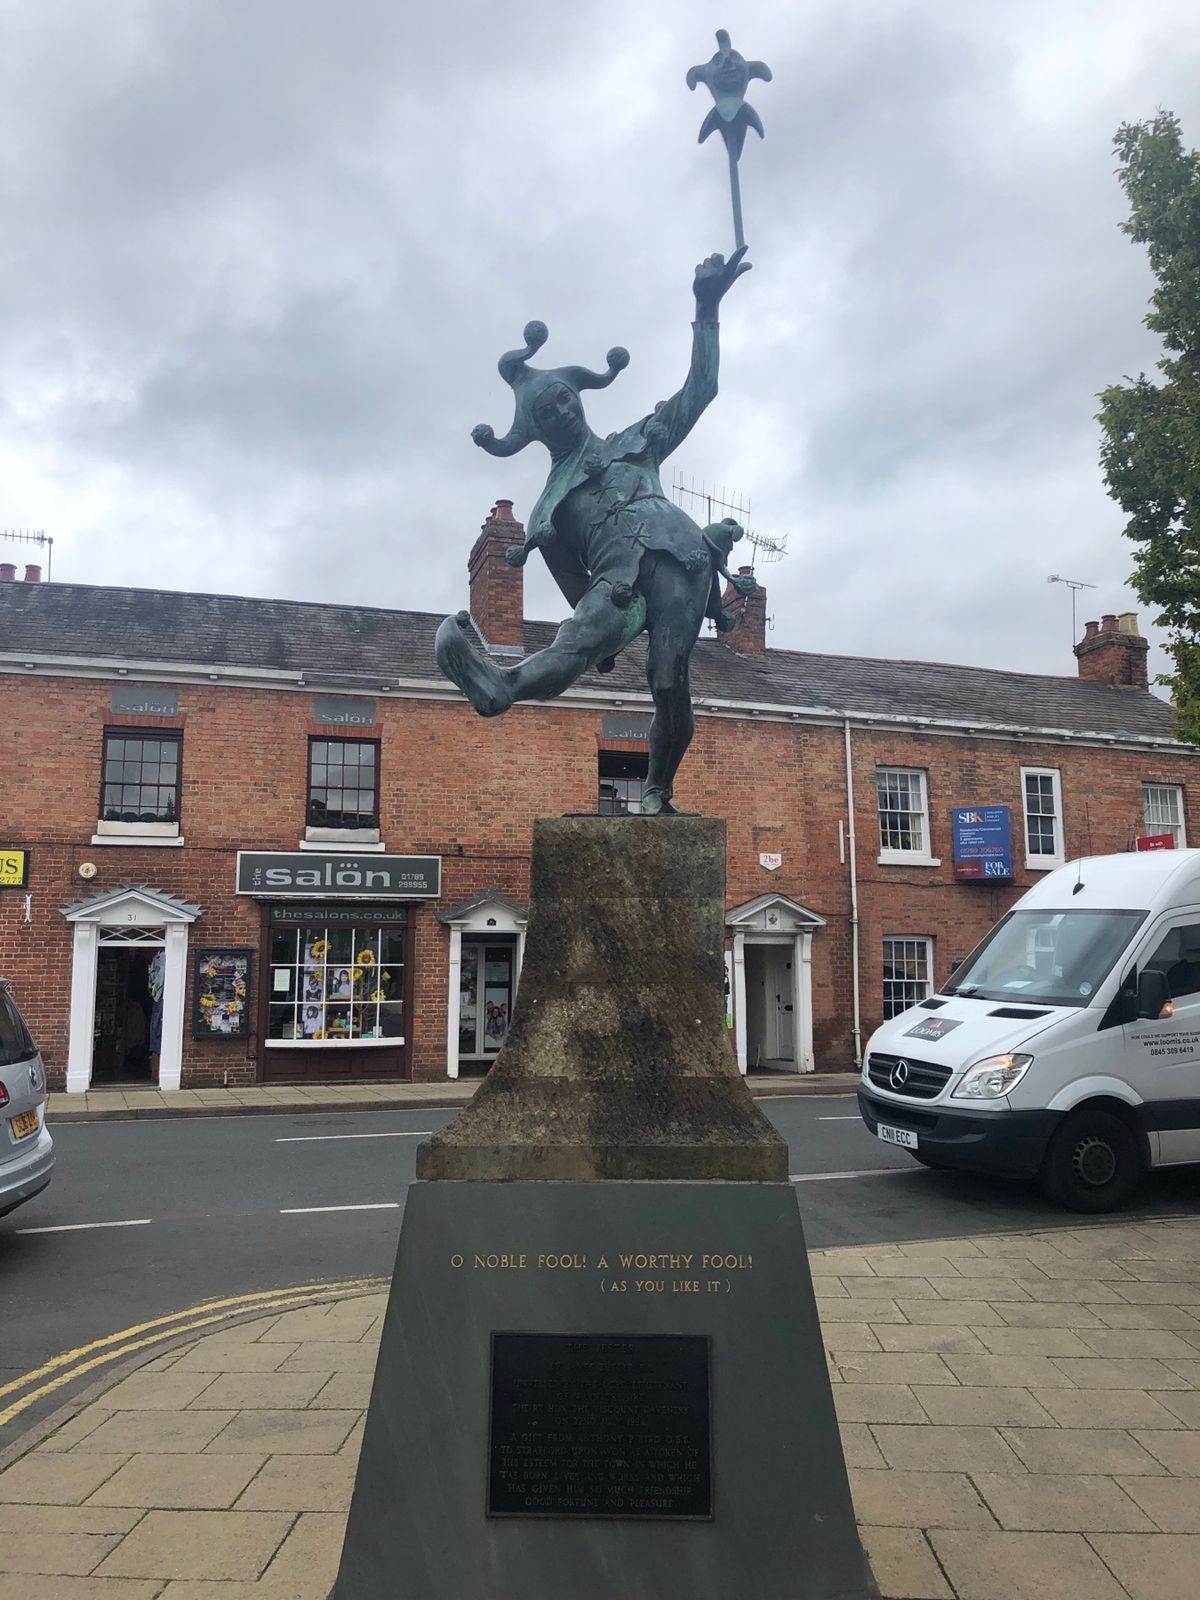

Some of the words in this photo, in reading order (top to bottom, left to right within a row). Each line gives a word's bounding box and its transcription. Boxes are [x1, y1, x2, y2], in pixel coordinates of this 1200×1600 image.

[985, 861, 1003, 869] FOR
[252, 867, 262, 886] the
[265, 862, 391, 887] salön
[985, 868, 1010, 876] SALE
[273, 908, 403, 920] thesalons.co.uk
[910, 1026, 945, 1038] LOOMIS
[1143, 1036, 1199, 1047] www.loomis.co.uk
[1150, 1047, 1166, 1056] 0845
[1179, 1046, 1194, 1054] 6419
[451, 1254, 464, 1269] O
[474, 1254, 527, 1269] NOBLE
[538, 1254, 587, 1269] FOOL!
[597, 1254, 609, 1269] A
[619, 1254, 693, 1269] WORTHY
[703, 1254, 753, 1269] FOOL!
[636, 1279, 665, 1293] YOU
[672, 1279, 701, 1293] LIKE
